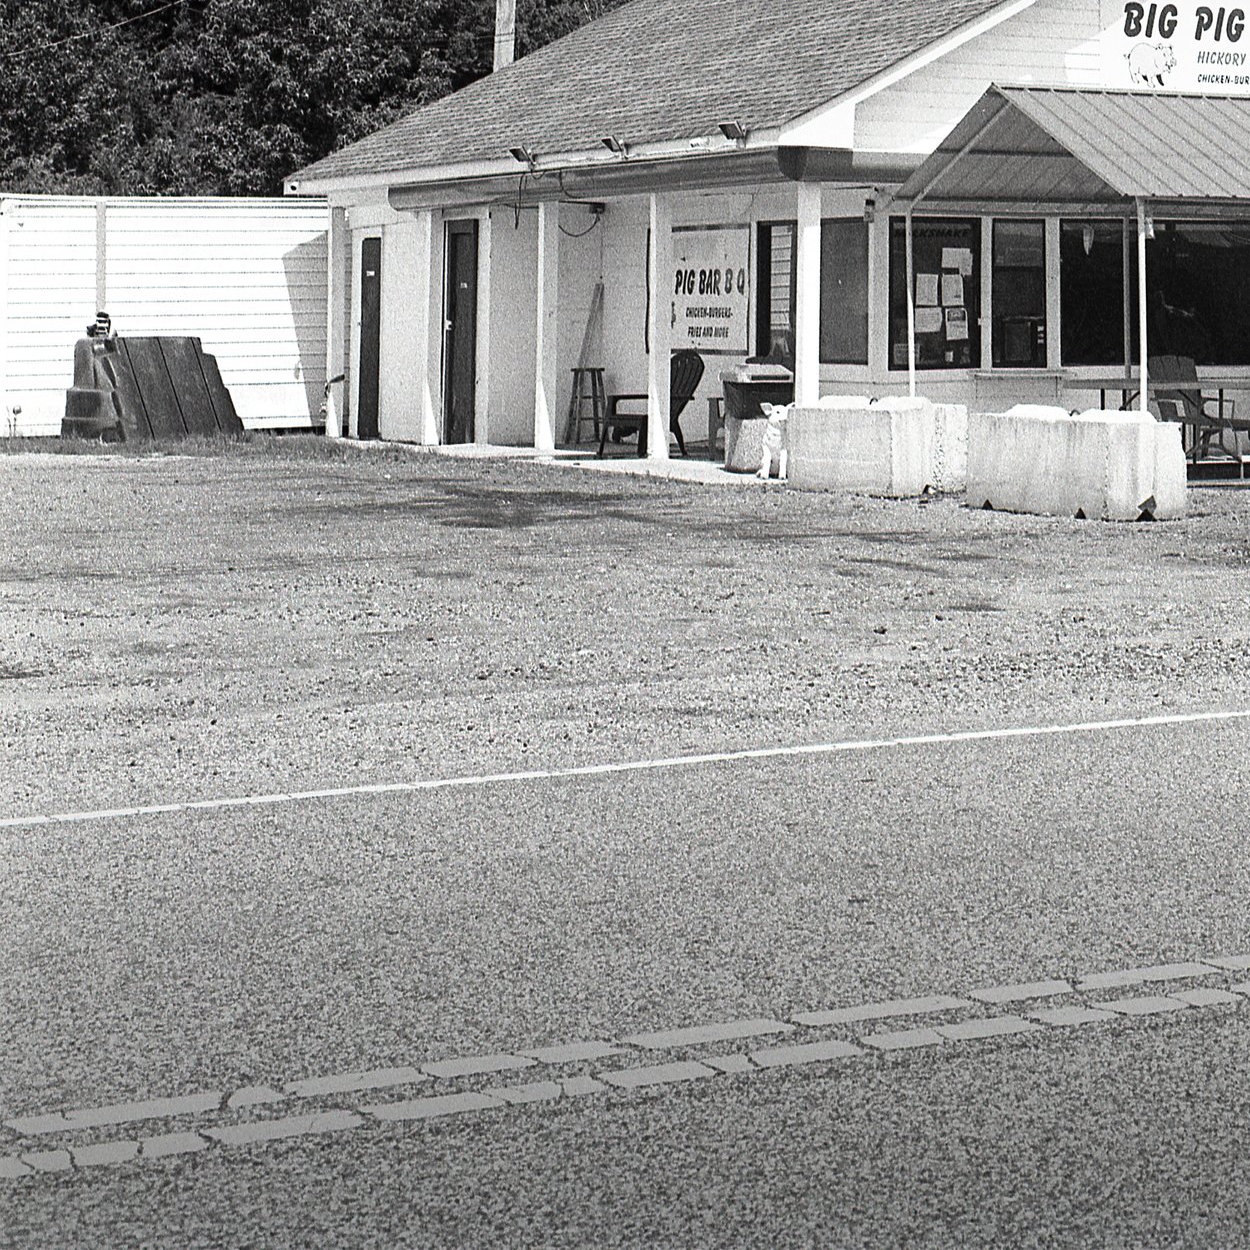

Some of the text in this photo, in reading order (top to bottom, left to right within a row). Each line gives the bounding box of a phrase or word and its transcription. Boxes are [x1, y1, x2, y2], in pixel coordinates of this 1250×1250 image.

[1123, 1, 1178, 39] BIG
[1194, 6, 1245, 43] PIG
[1197, 50, 1247, 66] HICKORY
[675, 268, 745, 296] PIG BAR B Q
[702, 326, 713, 338] AND
